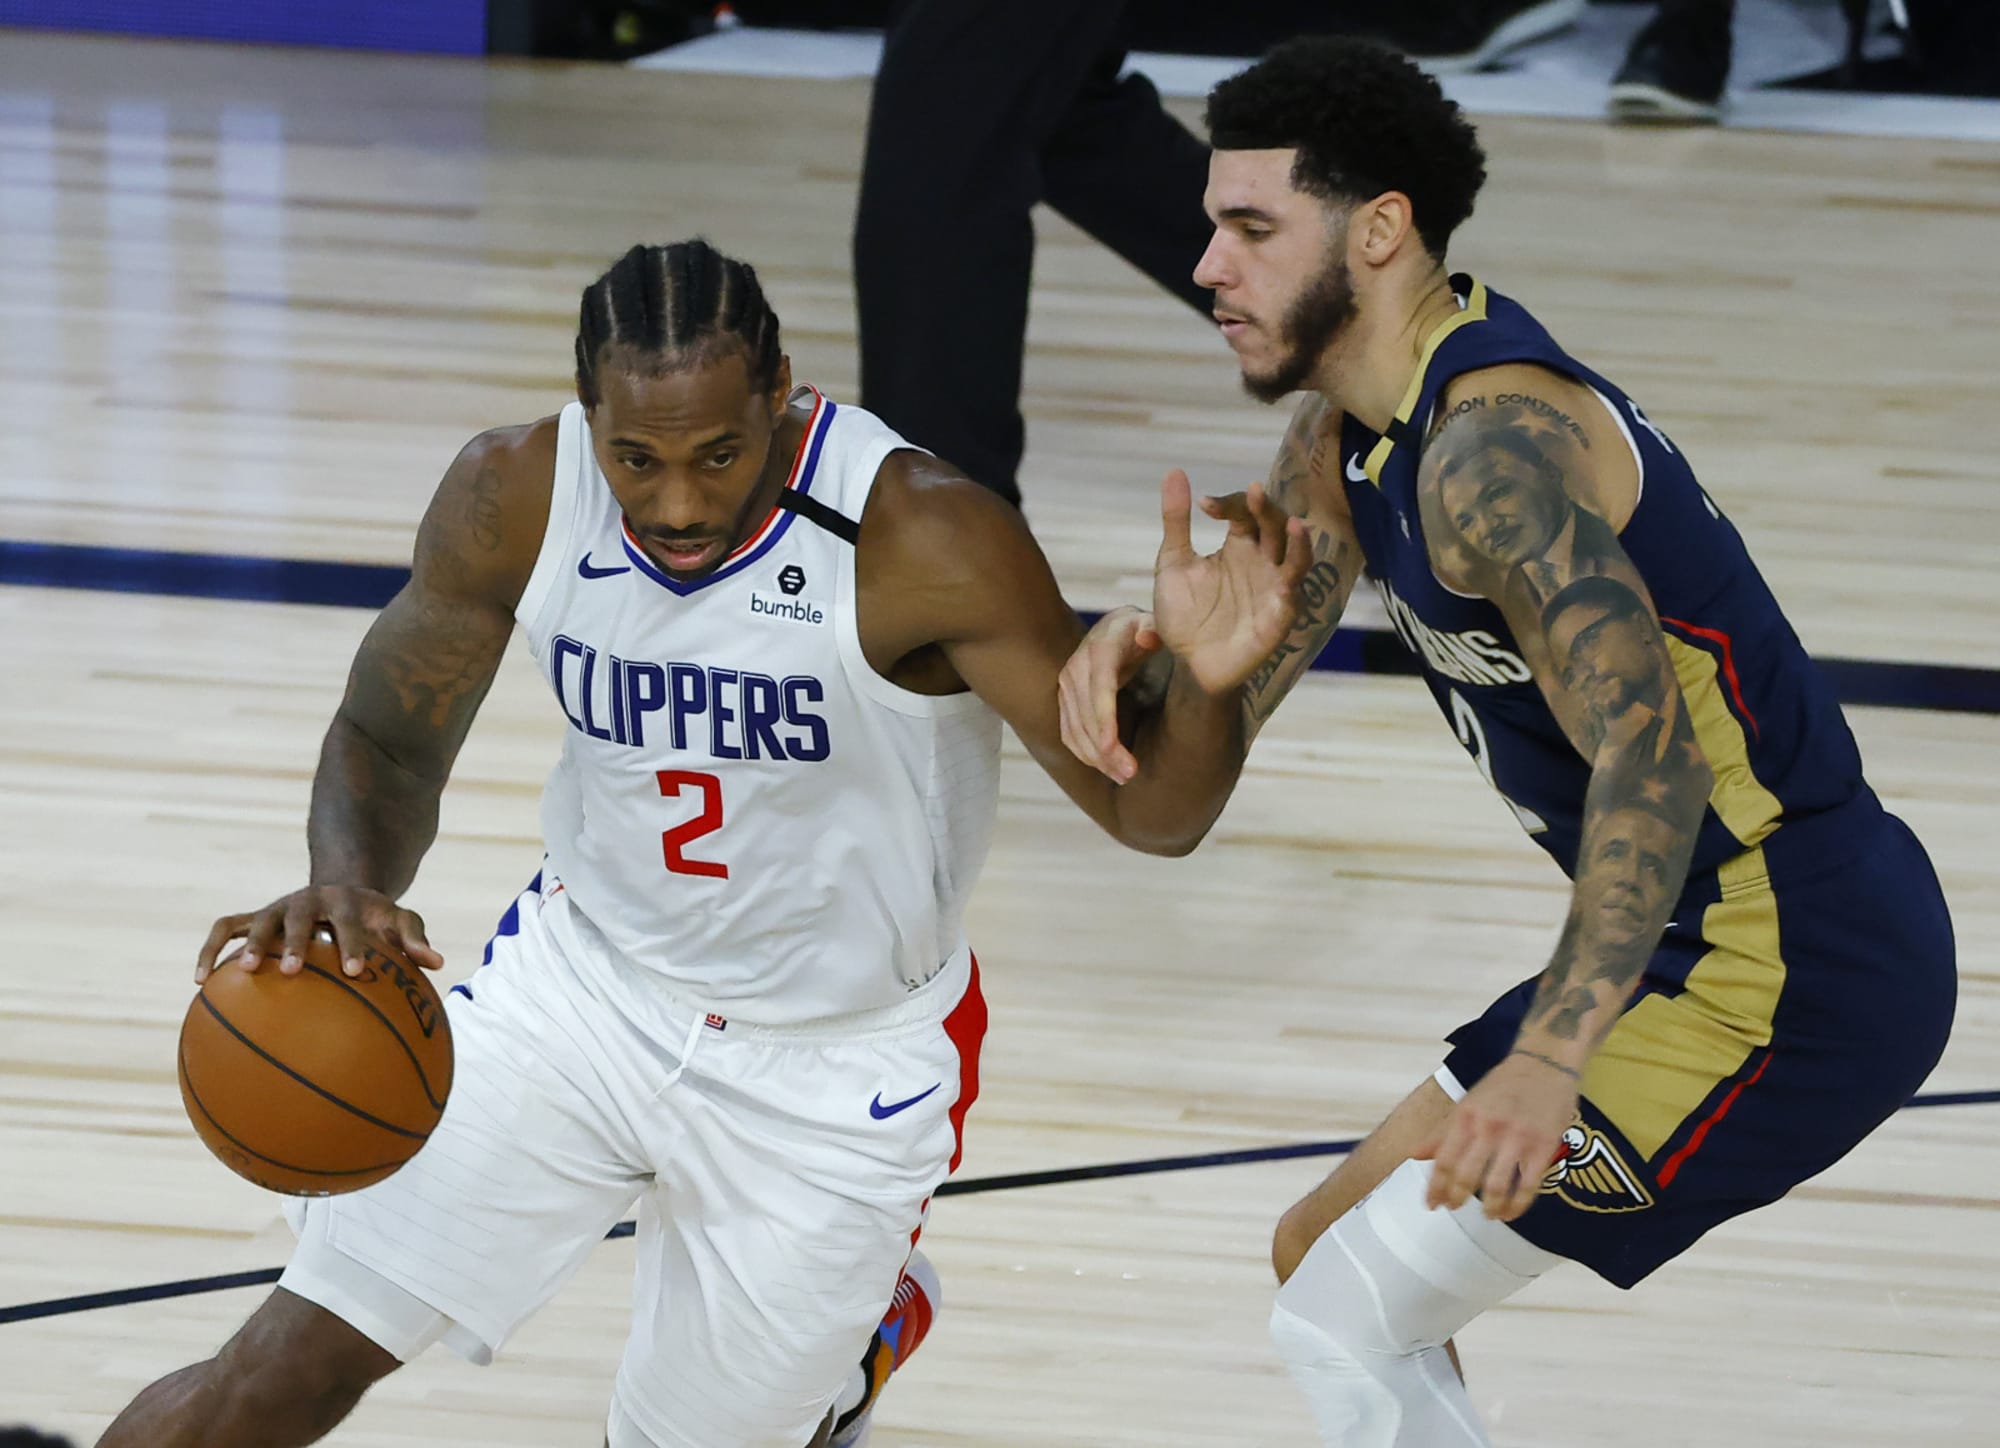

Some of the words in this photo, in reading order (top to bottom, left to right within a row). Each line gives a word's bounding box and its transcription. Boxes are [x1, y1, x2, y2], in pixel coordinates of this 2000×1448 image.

[750, 593, 823, 624] bumble
[550, 634, 831, 762] CLIPPERS
[655, 769, 729, 880] 2
